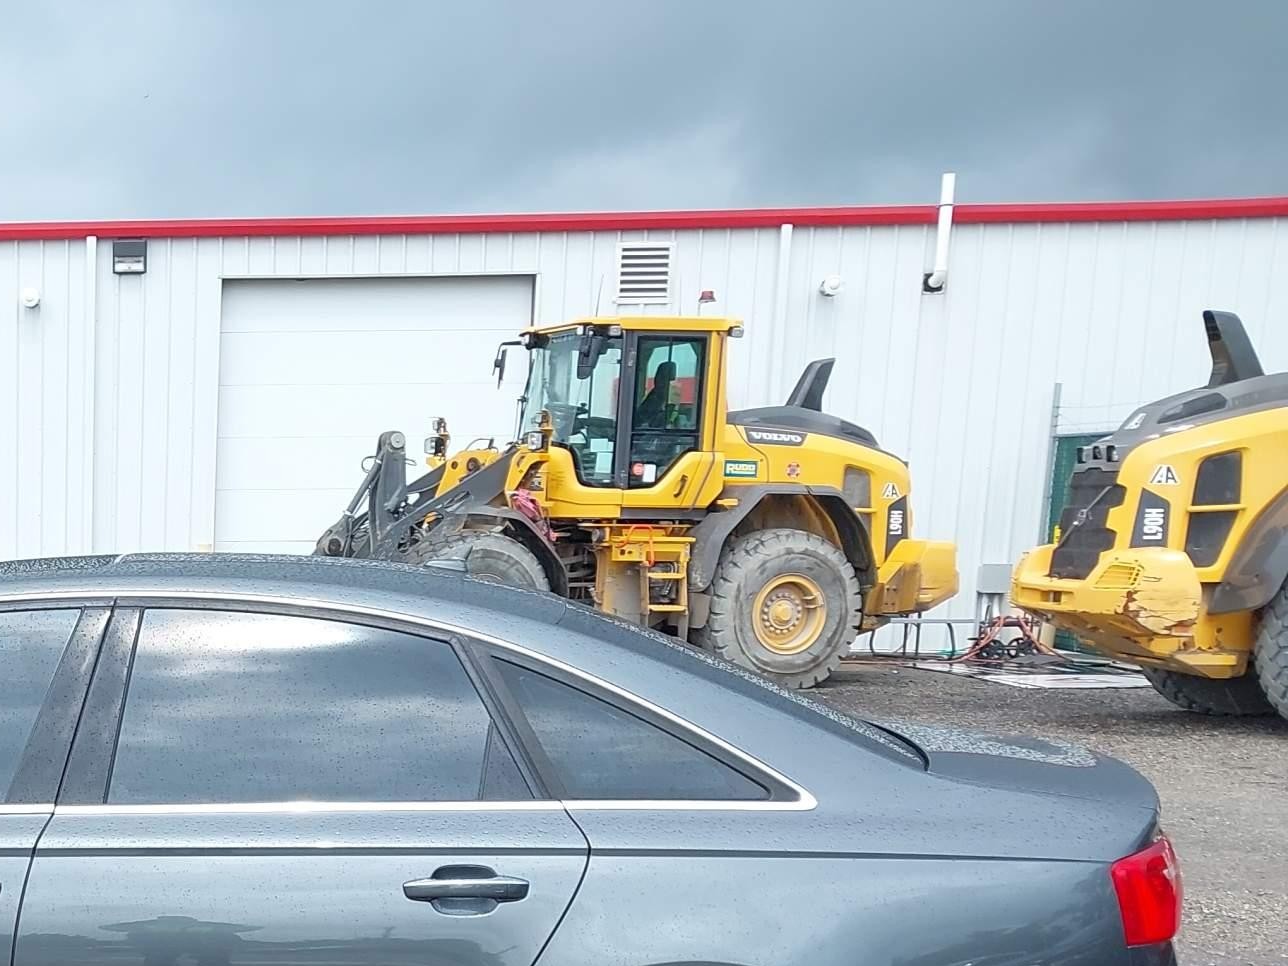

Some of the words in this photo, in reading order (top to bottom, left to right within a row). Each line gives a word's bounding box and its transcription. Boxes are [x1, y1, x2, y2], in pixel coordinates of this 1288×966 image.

[749, 431, 802, 443] VOLVO
[889, 510, 904, 535] L90H
[1142, 508, 1165, 540] L90H
